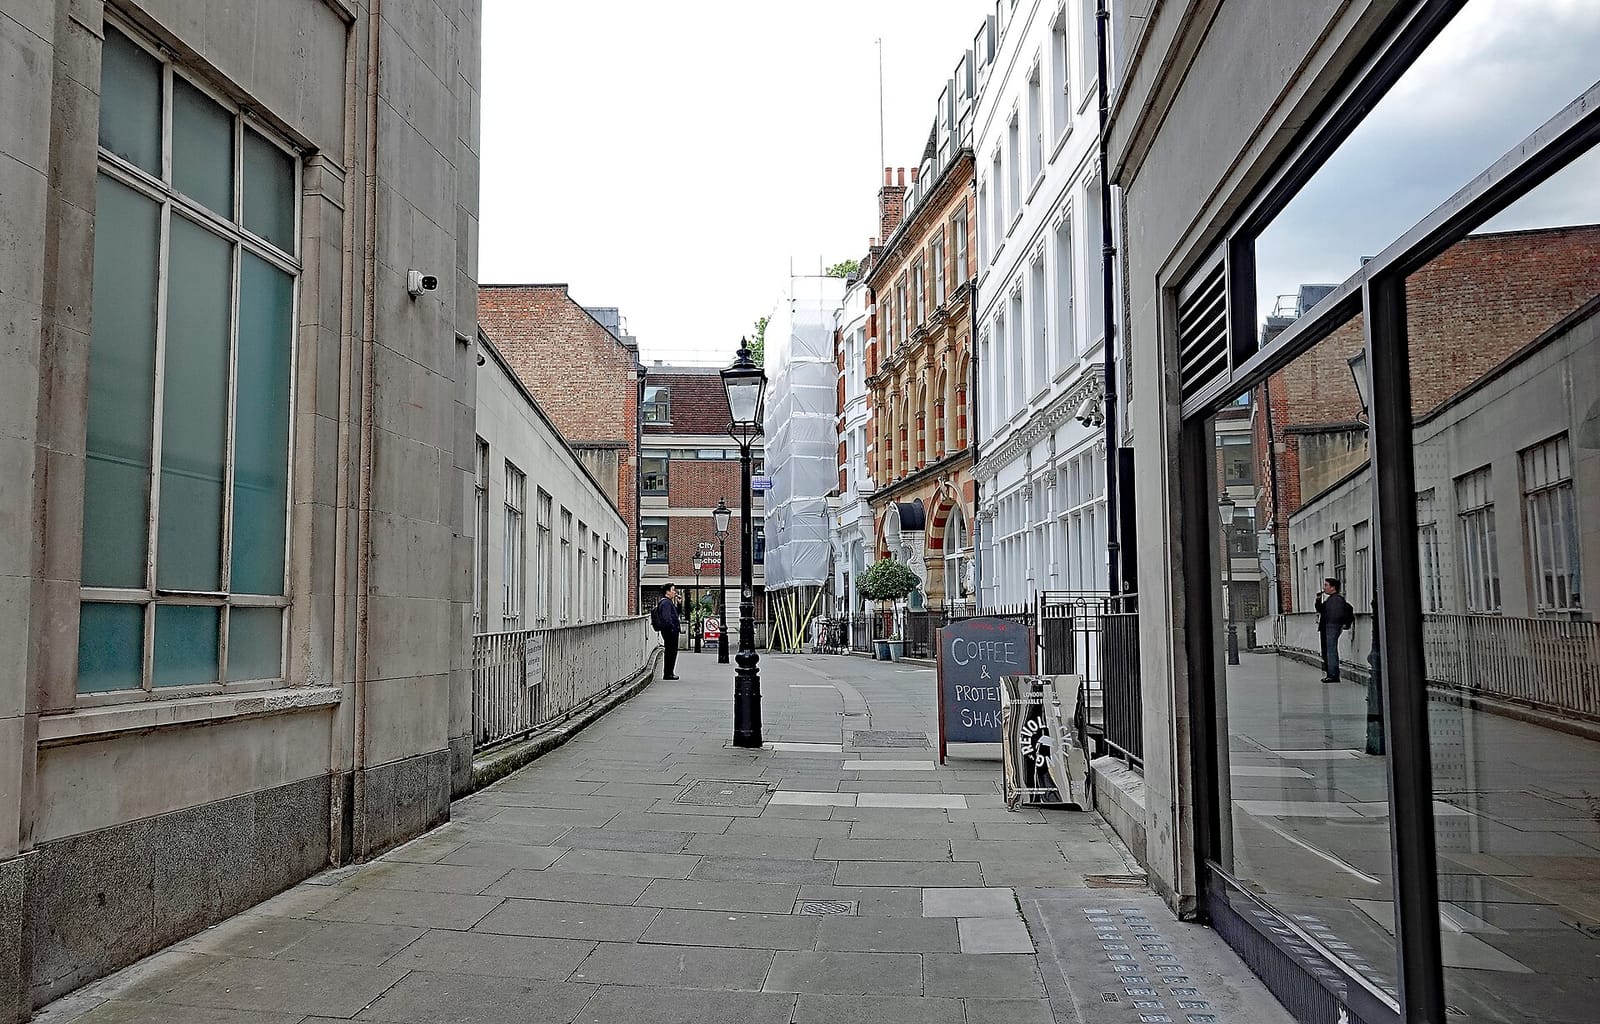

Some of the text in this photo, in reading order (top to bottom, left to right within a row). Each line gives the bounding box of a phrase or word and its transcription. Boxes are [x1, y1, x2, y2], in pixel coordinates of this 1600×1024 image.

[699, 542, 713, 551] City
[951, 637, 1018, 666] COFFEE
[980, 664, 991, 680] &
[955, 684, 1001, 702] PROTEI
[960, 708, 1002, 728] SHAK
[1019, 715, 1049, 756] REVOL
